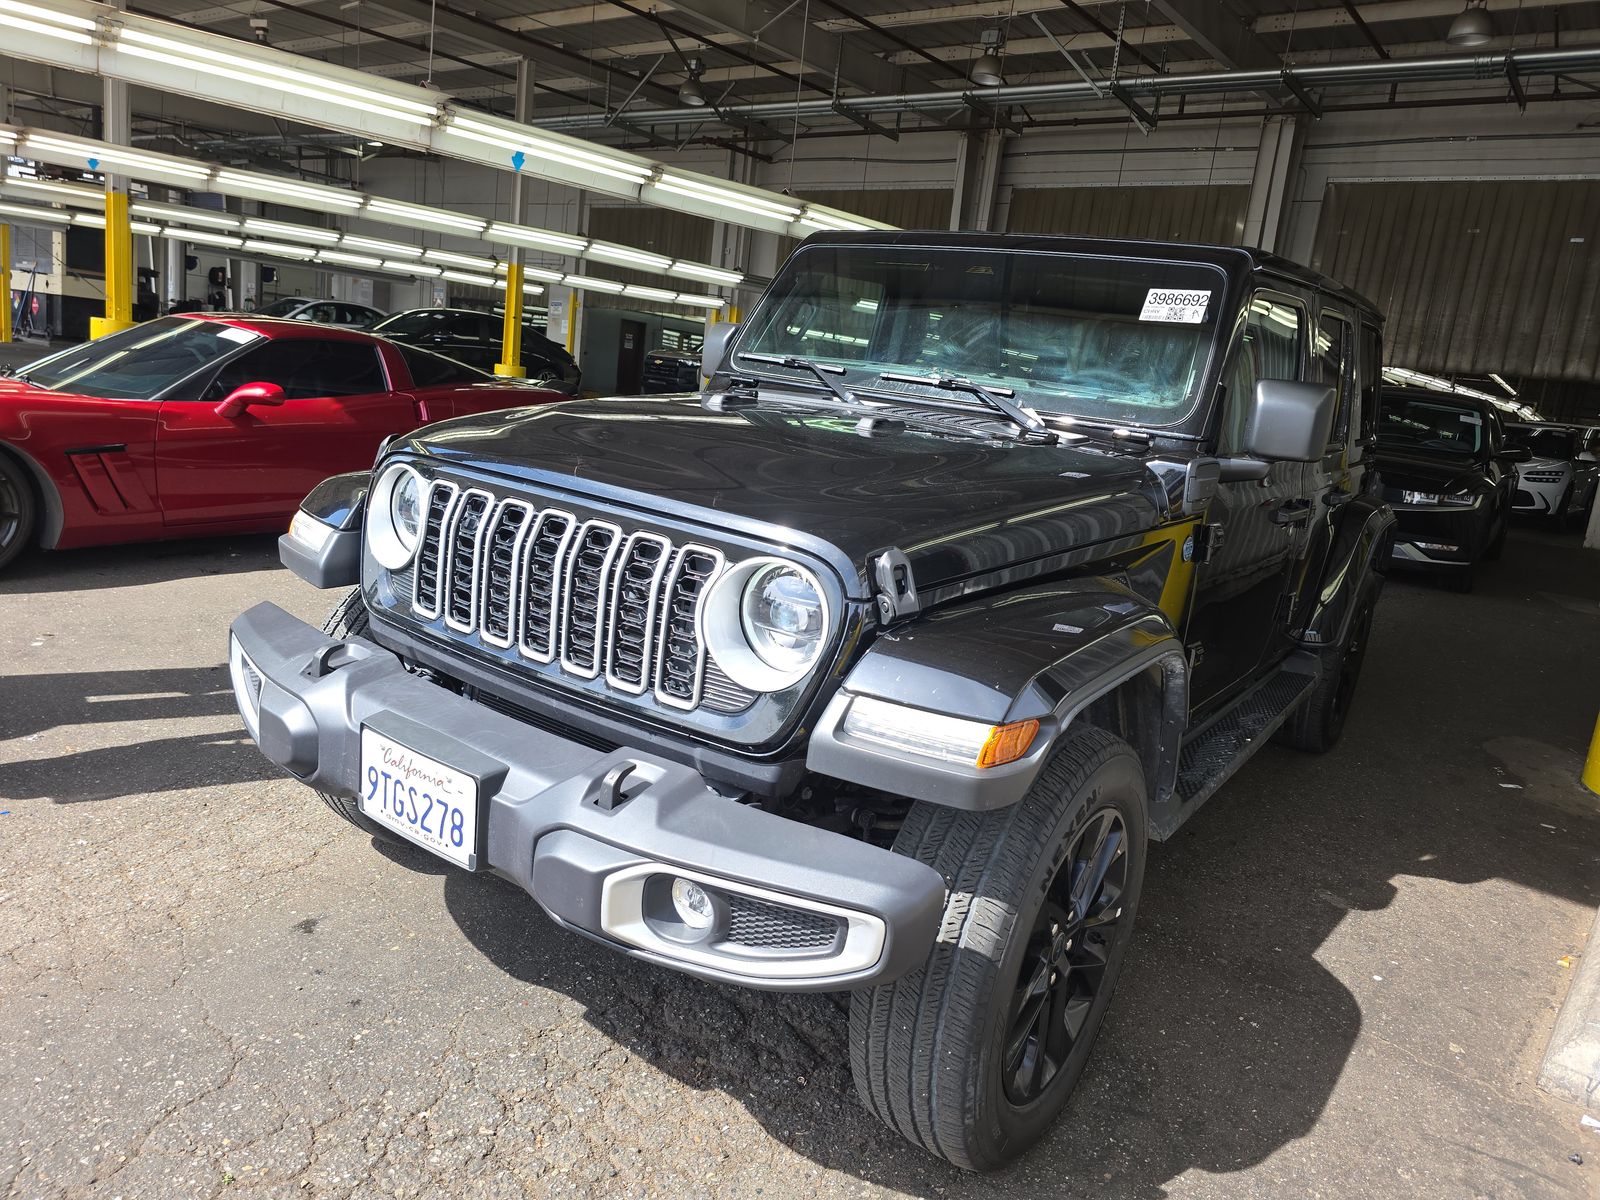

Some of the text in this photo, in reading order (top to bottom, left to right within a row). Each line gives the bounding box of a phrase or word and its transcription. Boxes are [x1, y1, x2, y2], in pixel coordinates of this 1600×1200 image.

[1148, 292, 1209, 307] 3986692
[383, 747, 452, 795] California
[367, 766, 464, 848] 9TGS278
[1041, 789, 1098, 893] NEXEN
